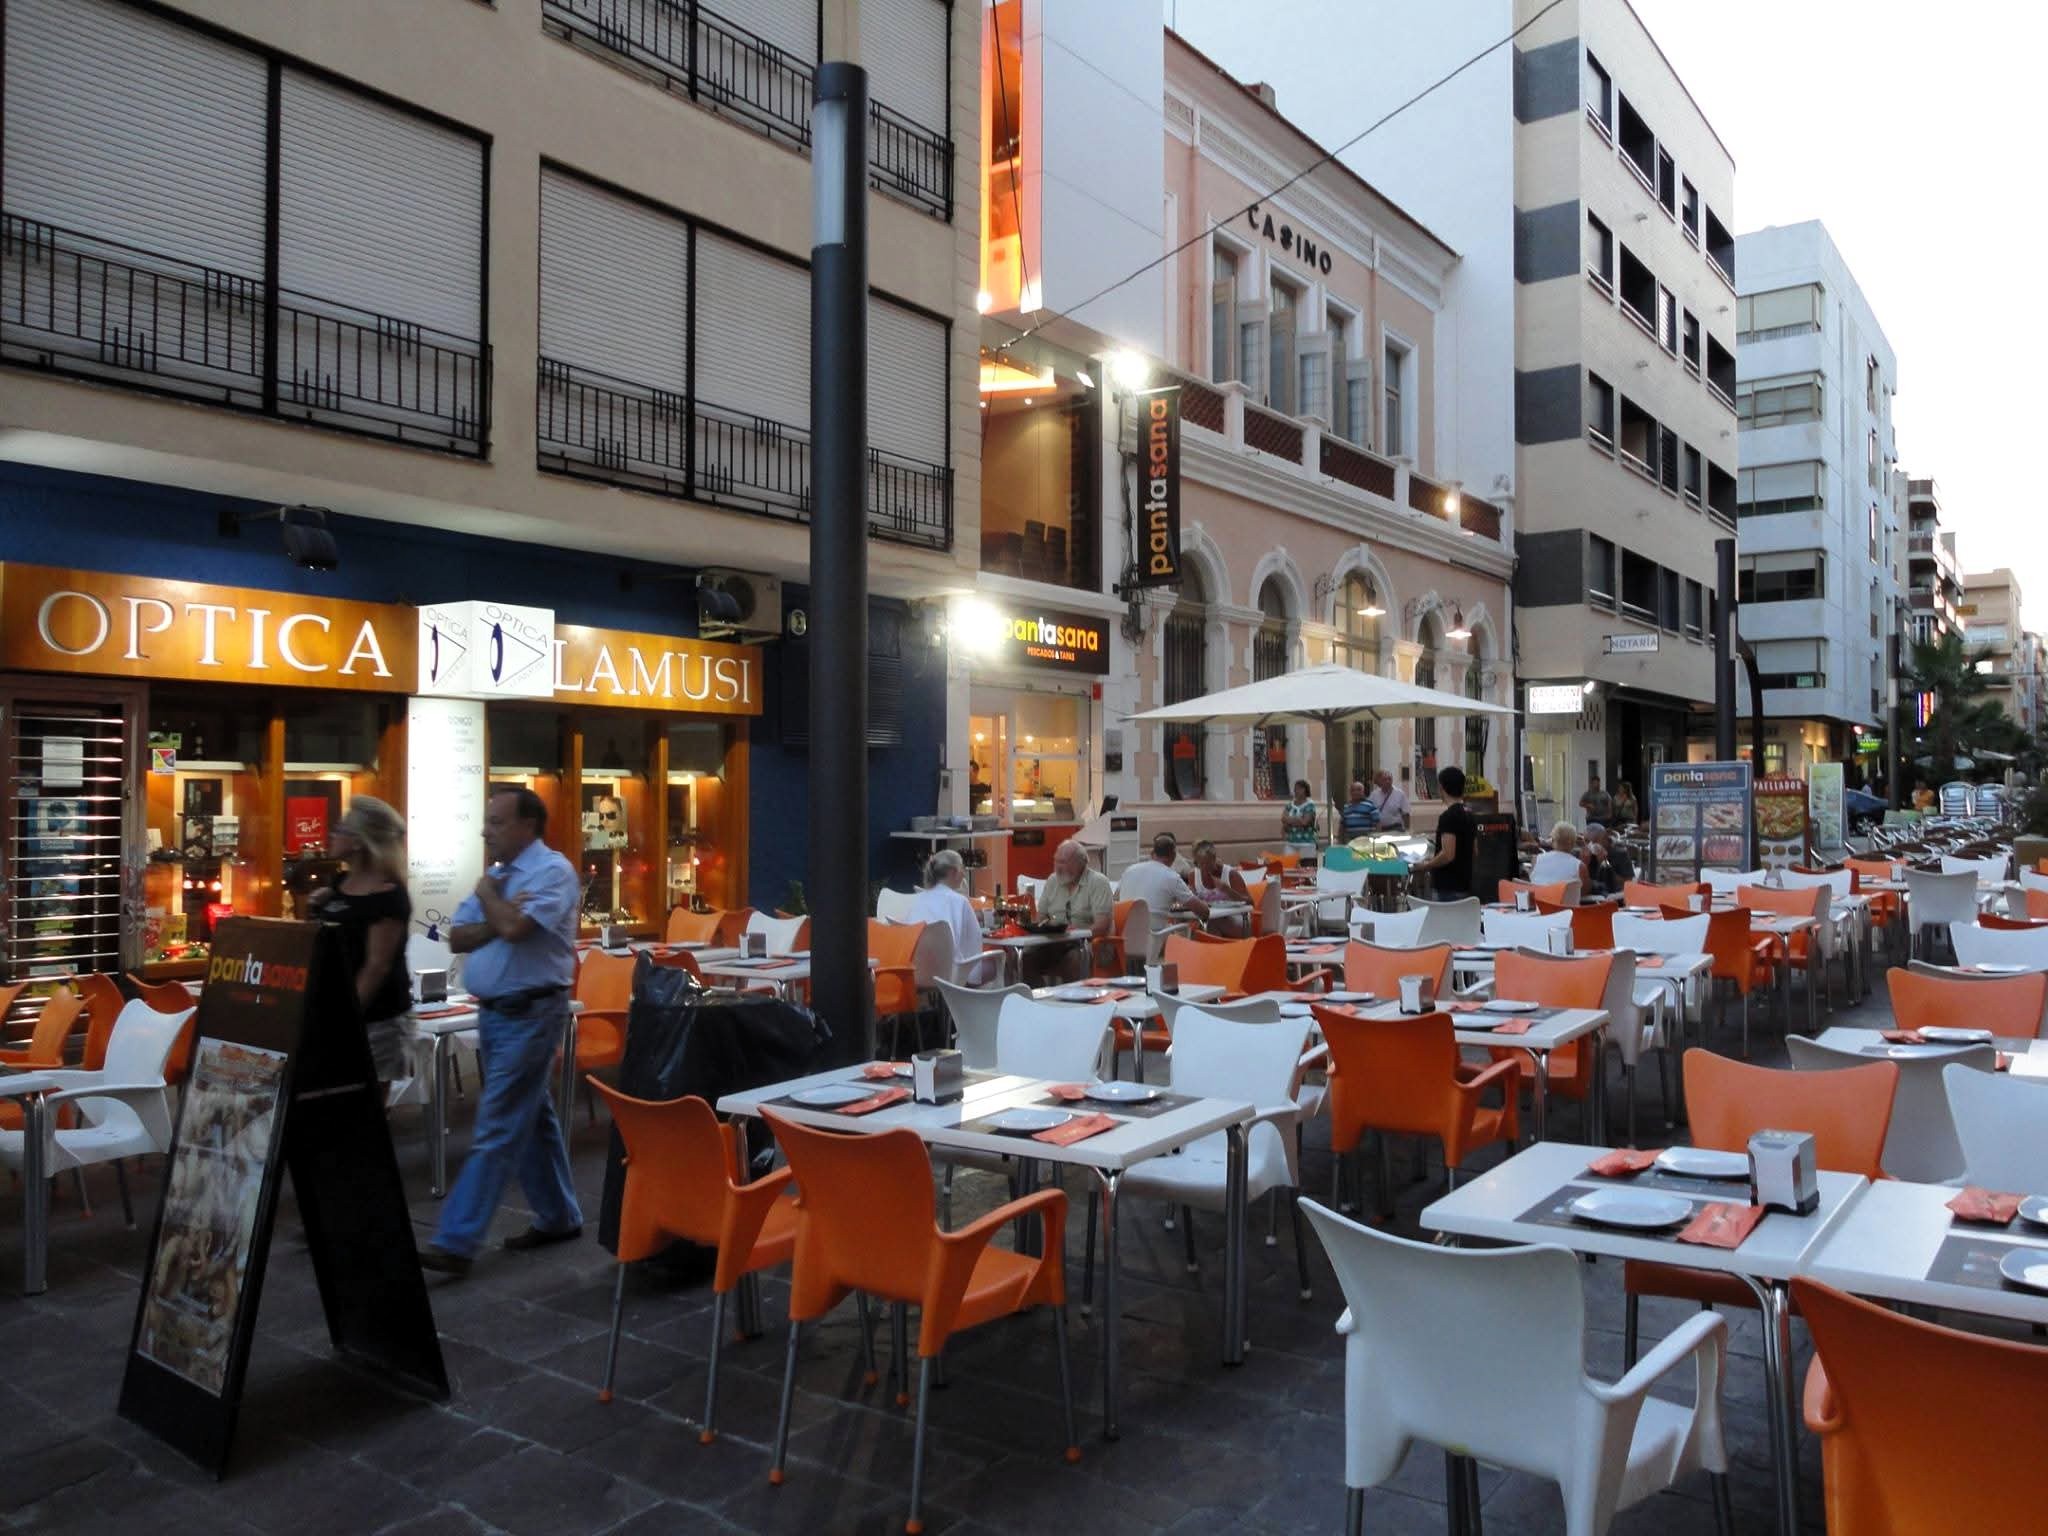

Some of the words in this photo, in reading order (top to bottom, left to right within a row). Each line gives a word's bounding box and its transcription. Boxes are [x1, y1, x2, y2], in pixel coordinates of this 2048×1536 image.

[1247, 203, 1332, 275] CASINO
[1145, 398, 1174, 576] pantasana
[37, 590, 394, 678] OPTICA
[486, 604, 549, 649] OPTICA
[1002, 616, 1099, 652] pantasana
[553, 639, 753, 705] LAMUSI
[1663, 769, 1738, 784] pantasana
[209, 952, 310, 991] pantasana
